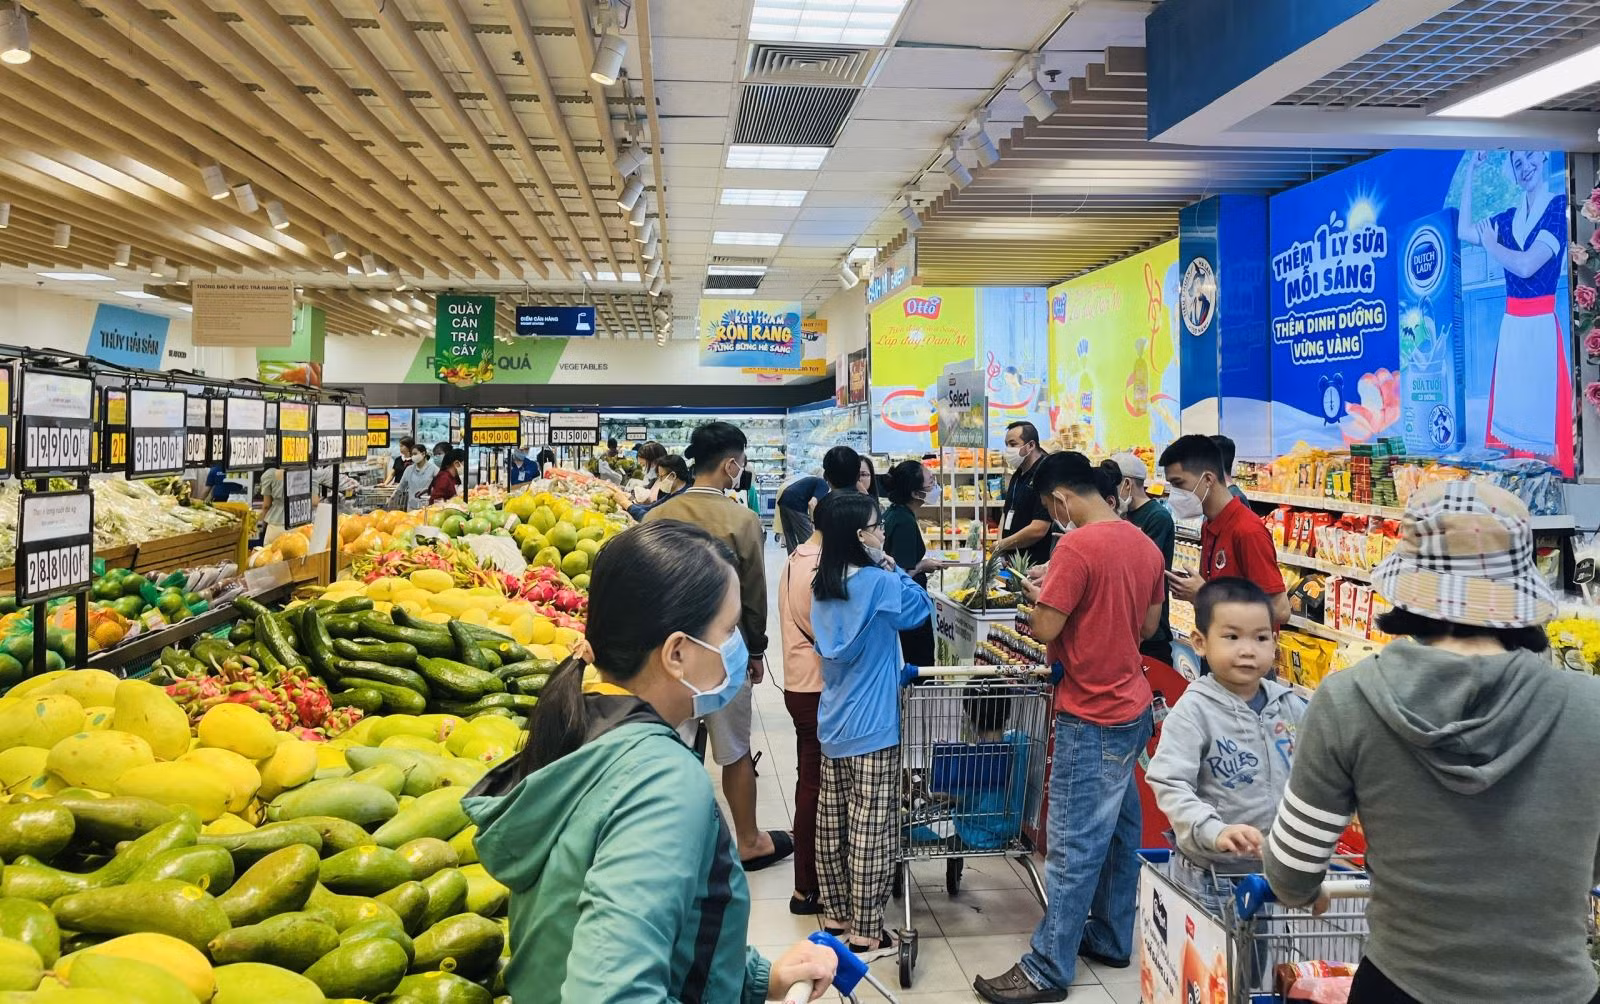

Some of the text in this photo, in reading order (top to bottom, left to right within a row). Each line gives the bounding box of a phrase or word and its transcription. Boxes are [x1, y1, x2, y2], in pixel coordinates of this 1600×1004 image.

[1275, 228, 1384, 277] THÊM 1 LY SỮA
[1413, 251, 1435, 265] DUTCH
[1416, 262, 1433, 274] LADY
[1287, 260, 1372, 304] MỖI SÁNG
[448, 301, 482, 315] QUẦY
[452, 316, 478, 328] CÂN
[1276, 307, 1383, 338] THÊM DINH DƯỠNG
[451, 330, 478, 342] TRÁI
[1294, 333, 1360, 358] VỮNG VÀNG
[452, 344, 477, 356] CÂY
[559, 363, 608, 371] VEGETABLES
[949, 388, 970, 408] Select
[553, 429, 588, 440] 31.500
[30, 434, 79, 459] 19.900
[136, 441, 175, 463] 31.300
[30, 553, 79, 585] 28.800
[936, 613, 955, 641] Select
